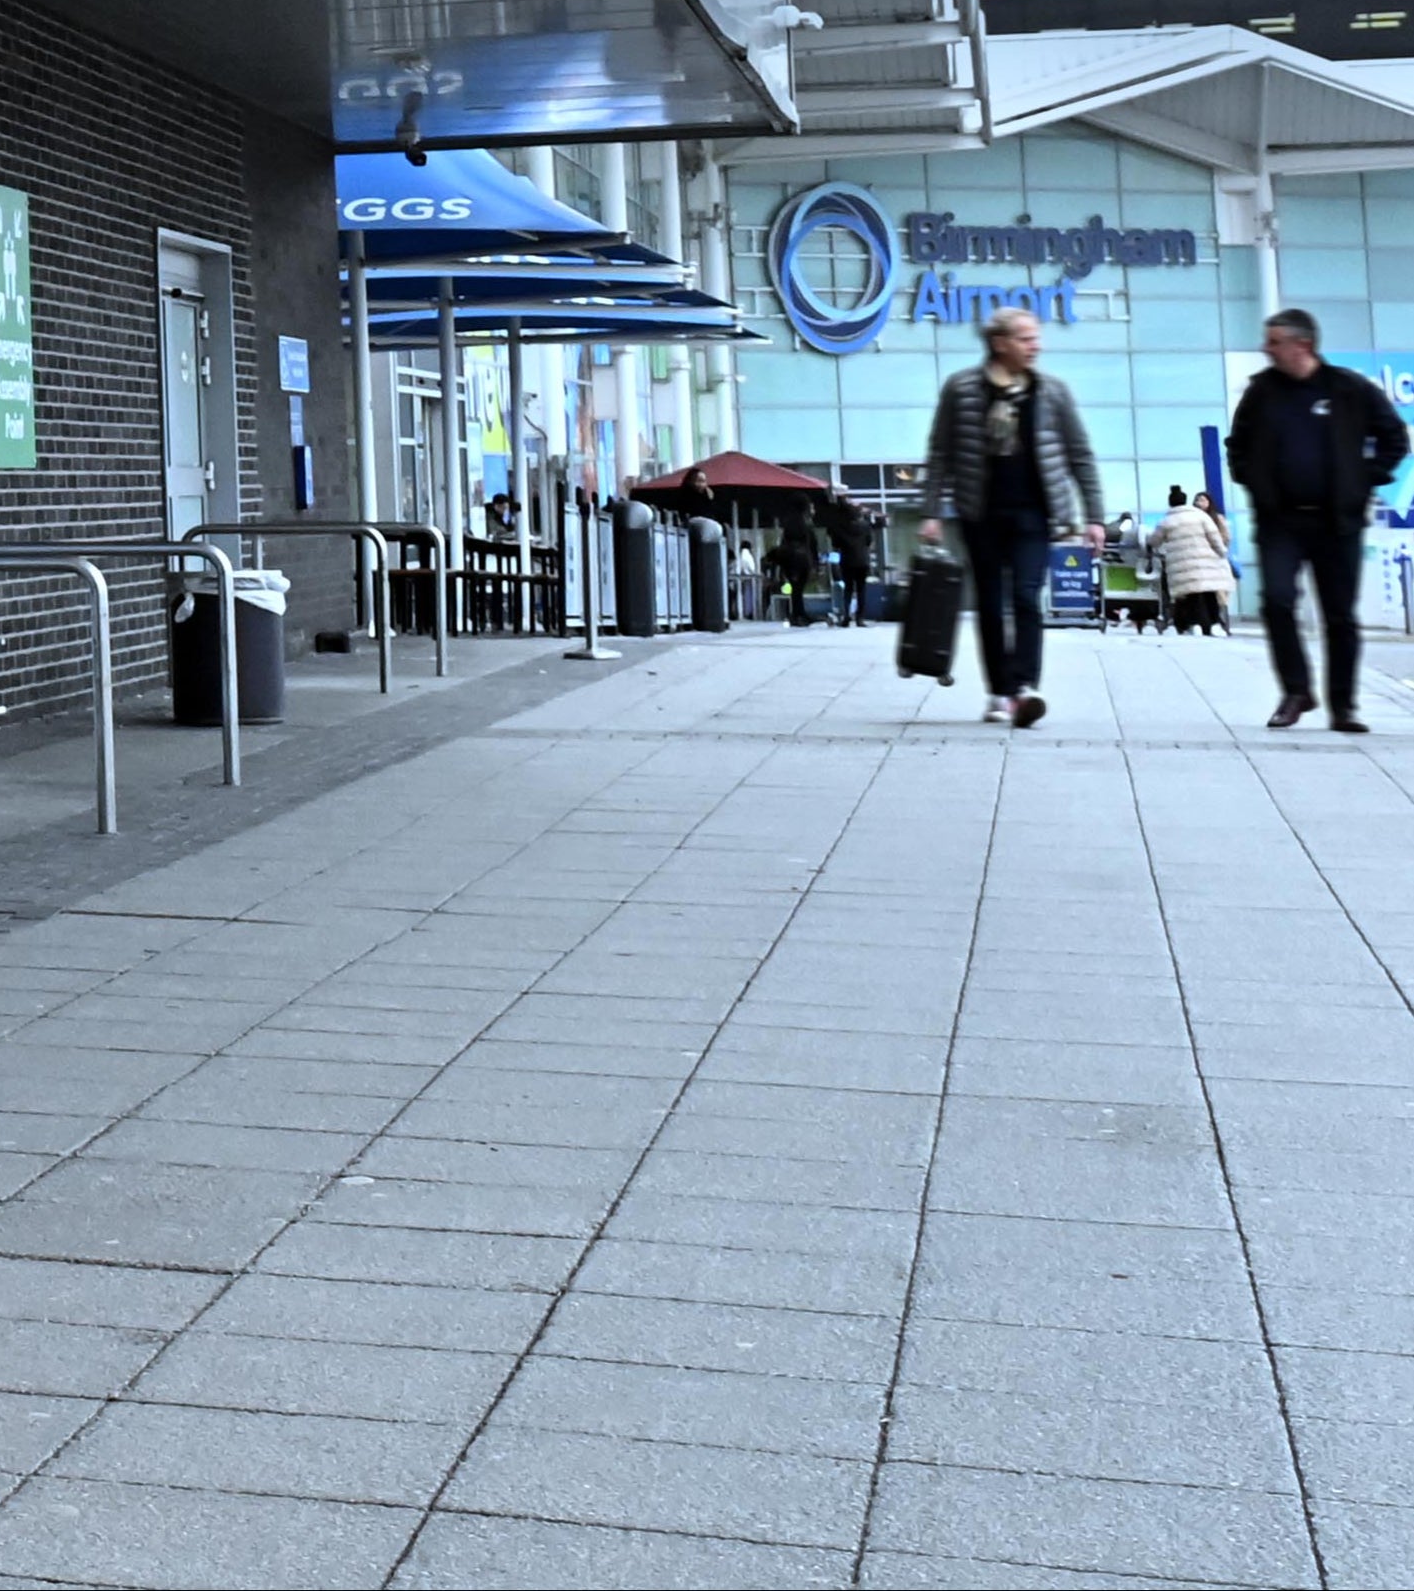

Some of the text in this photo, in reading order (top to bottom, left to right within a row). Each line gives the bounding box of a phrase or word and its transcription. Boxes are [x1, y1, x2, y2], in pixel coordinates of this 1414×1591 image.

[336, 197, 472, 221] GGS
[908, 211, 1196, 280] Birmingham
[5, 412, 24, 439] Point
